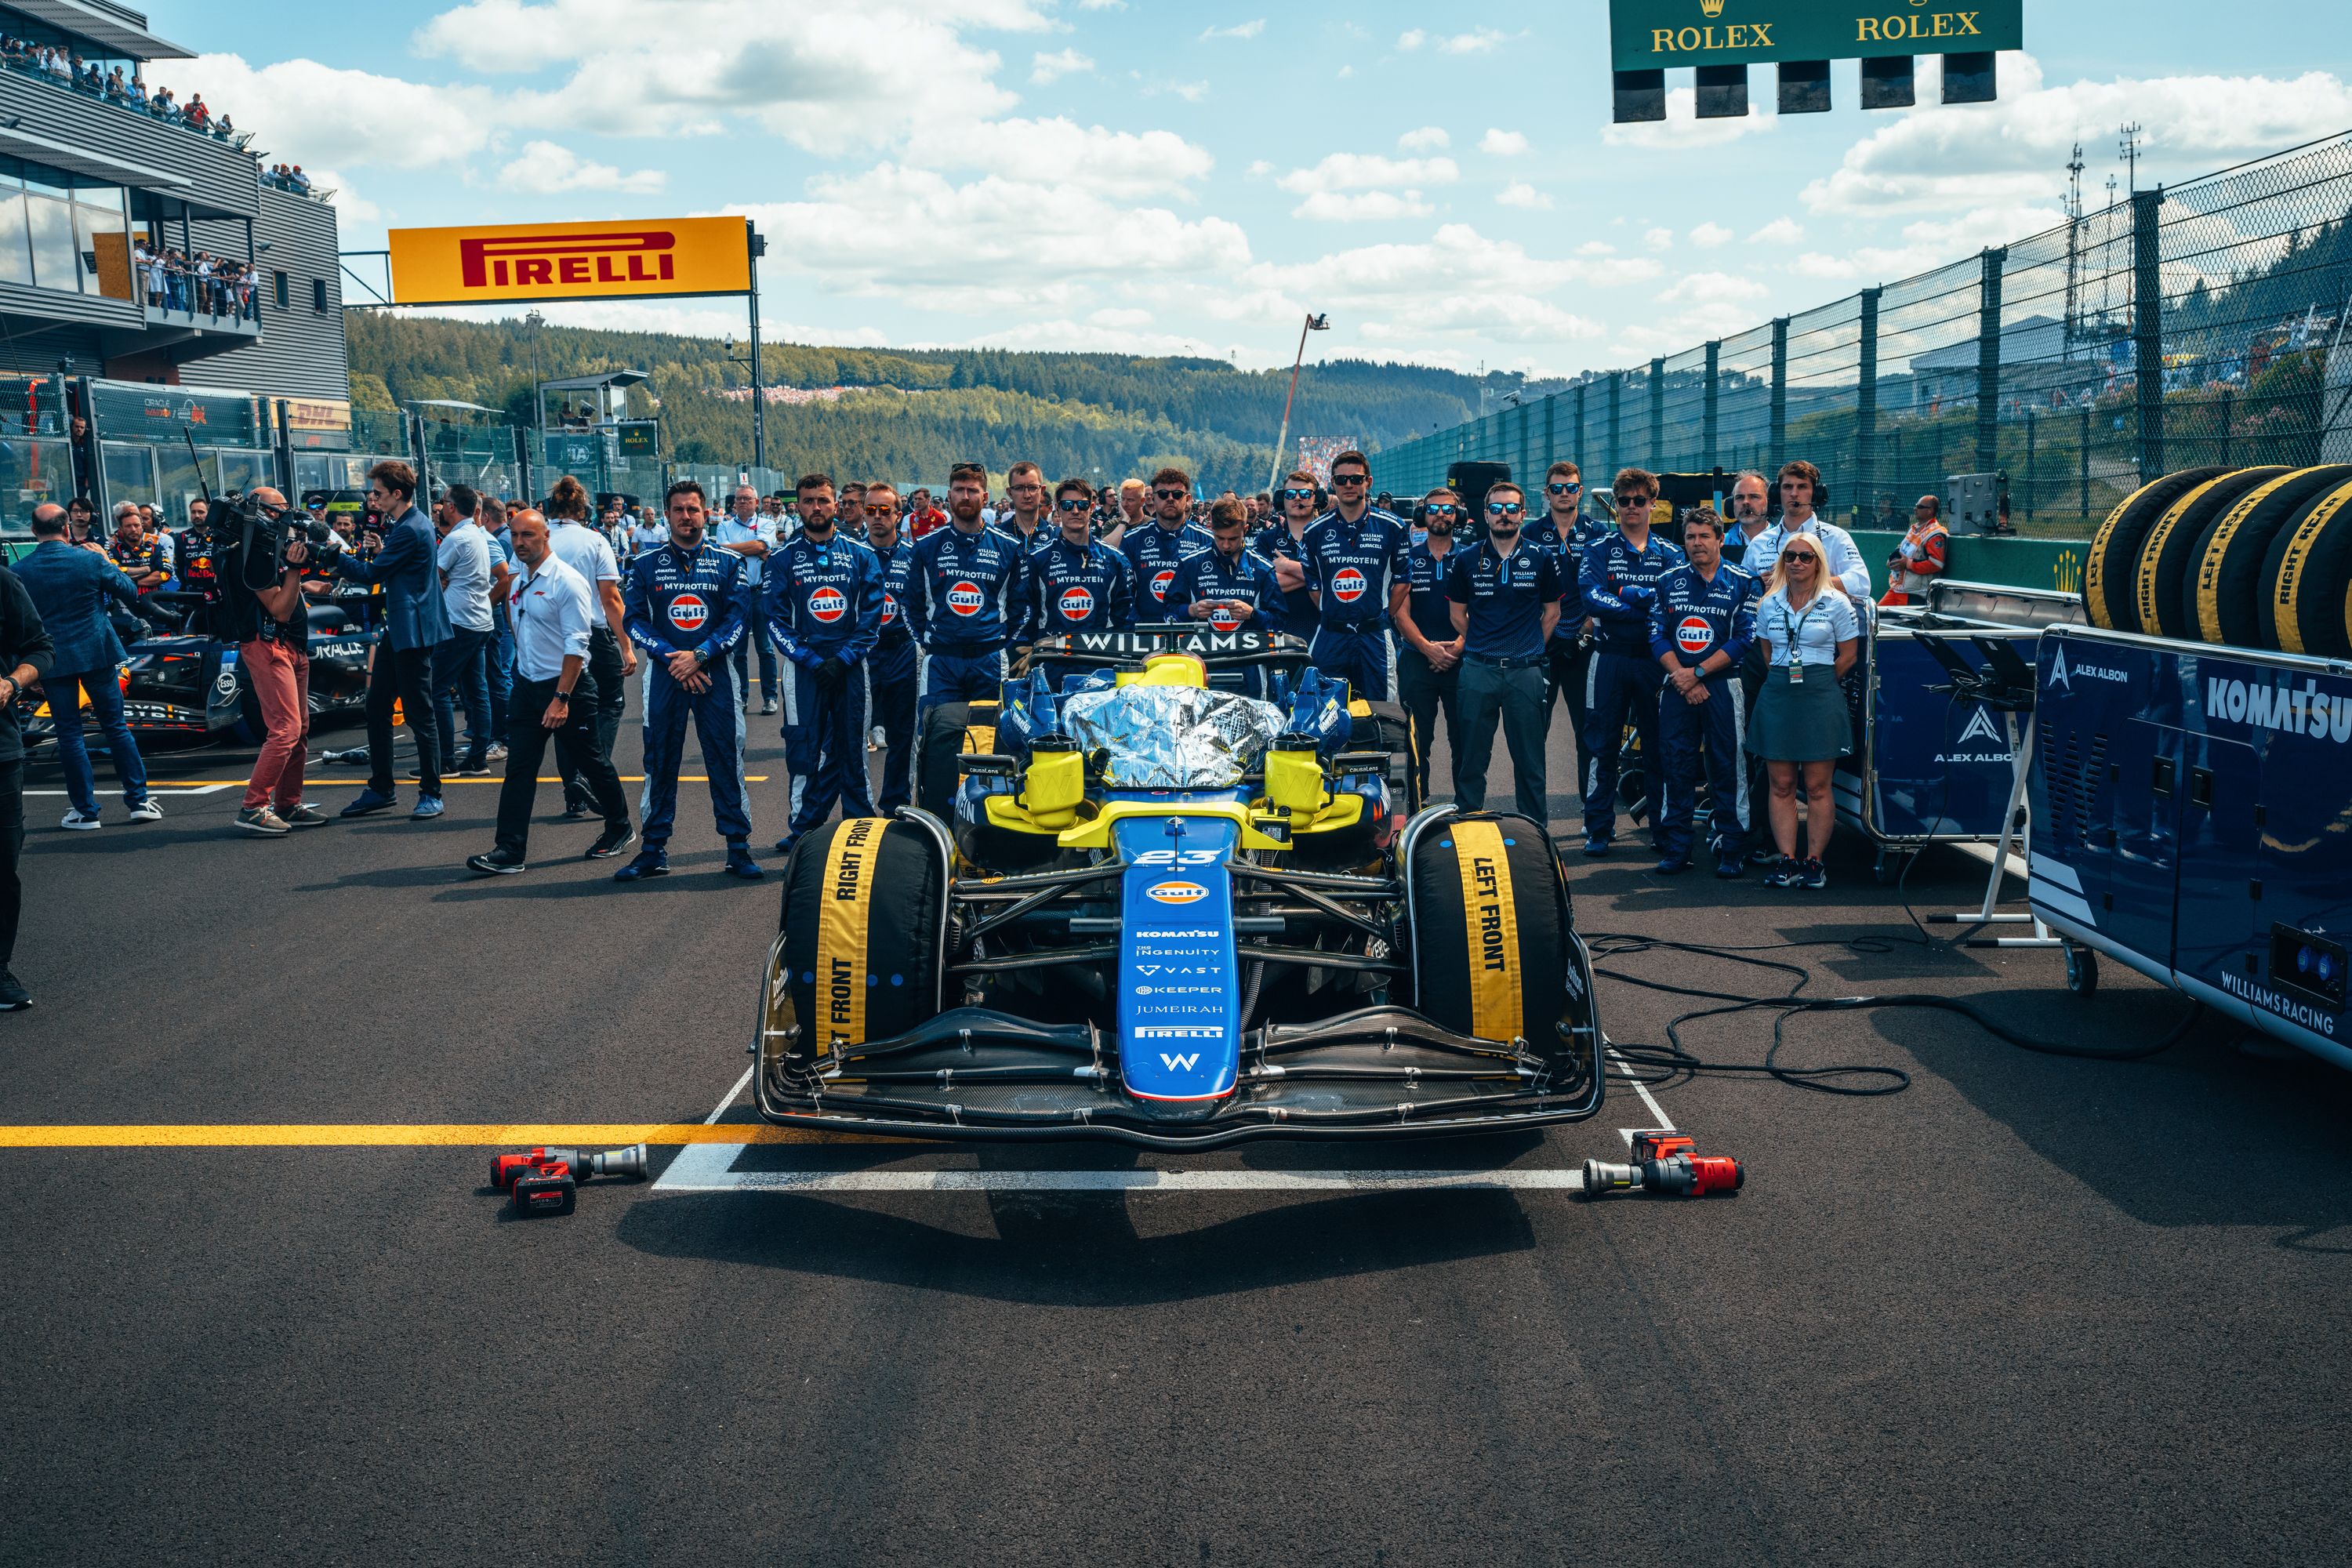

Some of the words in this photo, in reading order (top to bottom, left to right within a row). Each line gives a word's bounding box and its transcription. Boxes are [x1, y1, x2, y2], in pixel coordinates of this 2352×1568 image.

[1857, 11, 1982, 42] ROLEX
[1651, 24, 1775, 53] ROLEX
[459, 231, 676, 288] PIRELLI
[296, 403, 339, 426] DHL
[2201, 546, 2220, 590] LEFT
[2218, 497, 2256, 539] REAR
[2279, 546, 2302, 604] RIGHT
[2298, 496, 2342, 540] REAR
[977, 548, 1000, 557] WILLIAMS
[1329, 557, 1380, 565] MYPROTEIN
[2141, 568, 2152, 619] RIGHT
[2147, 511, 2176, 562] FRONT
[946, 569, 996, 582] MYPROTEIN
[2090, 551, 2100, 588] LEFT
[804, 574, 851, 584] MYPROTEN
[1616, 573, 1658, 583] MYPROTEI
[664, 583, 719, 592] MYPROTEIN
[1152, 582, 1168, 591] Gu
[1334, 580, 1365, 591] Gulf
[949, 593, 982, 604] Gulf
[1207, 589, 1254, 597] MYPROTEIN
[810, 598, 845, 611] Gulf
[1060, 598, 1092, 609] Gulf
[670, 607, 706, 618] Gulf
[1211, 611, 1231, 621] Gu
[1675, 604, 1727, 617] MYPROTEIN
[768, 621, 797, 654] KOMATSU
[1678, 628, 1711, 640] Gulf
[1080, 632, 1261, 652] WILLAMS
[2076, 663, 2097, 677] ALEX
[2097, 667, 2128, 683] ALBON
[220, 677, 234, 688] Esso
[2207, 677, 2352, 743] KOMATSU
[1934, 753, 1972, 762] ALEX
[1974, 753, 2013, 762] ALBO
[846, 819, 875, 848] FRONT
[1133, 849, 1221, 865] 23
[837, 851, 862, 901] RIGHT
[1474, 858, 1498, 898] LEFT
[1152, 887, 1207, 897] Gulf
[1480, 904, 1505, 972] FRONT
[1136, 949, 1220, 957] INGENUITY
[831, 957, 851, 1024] FRONT
[2221, 970, 2281, 1013] WILLIAMS
[2282, 996, 2334, 1035] RACING
[1136, 1005, 1223, 1015] JUMEIRAH
[1134, 1025, 1223, 1039] PIRELLI
[1160, 1053, 1200, 1072] W
